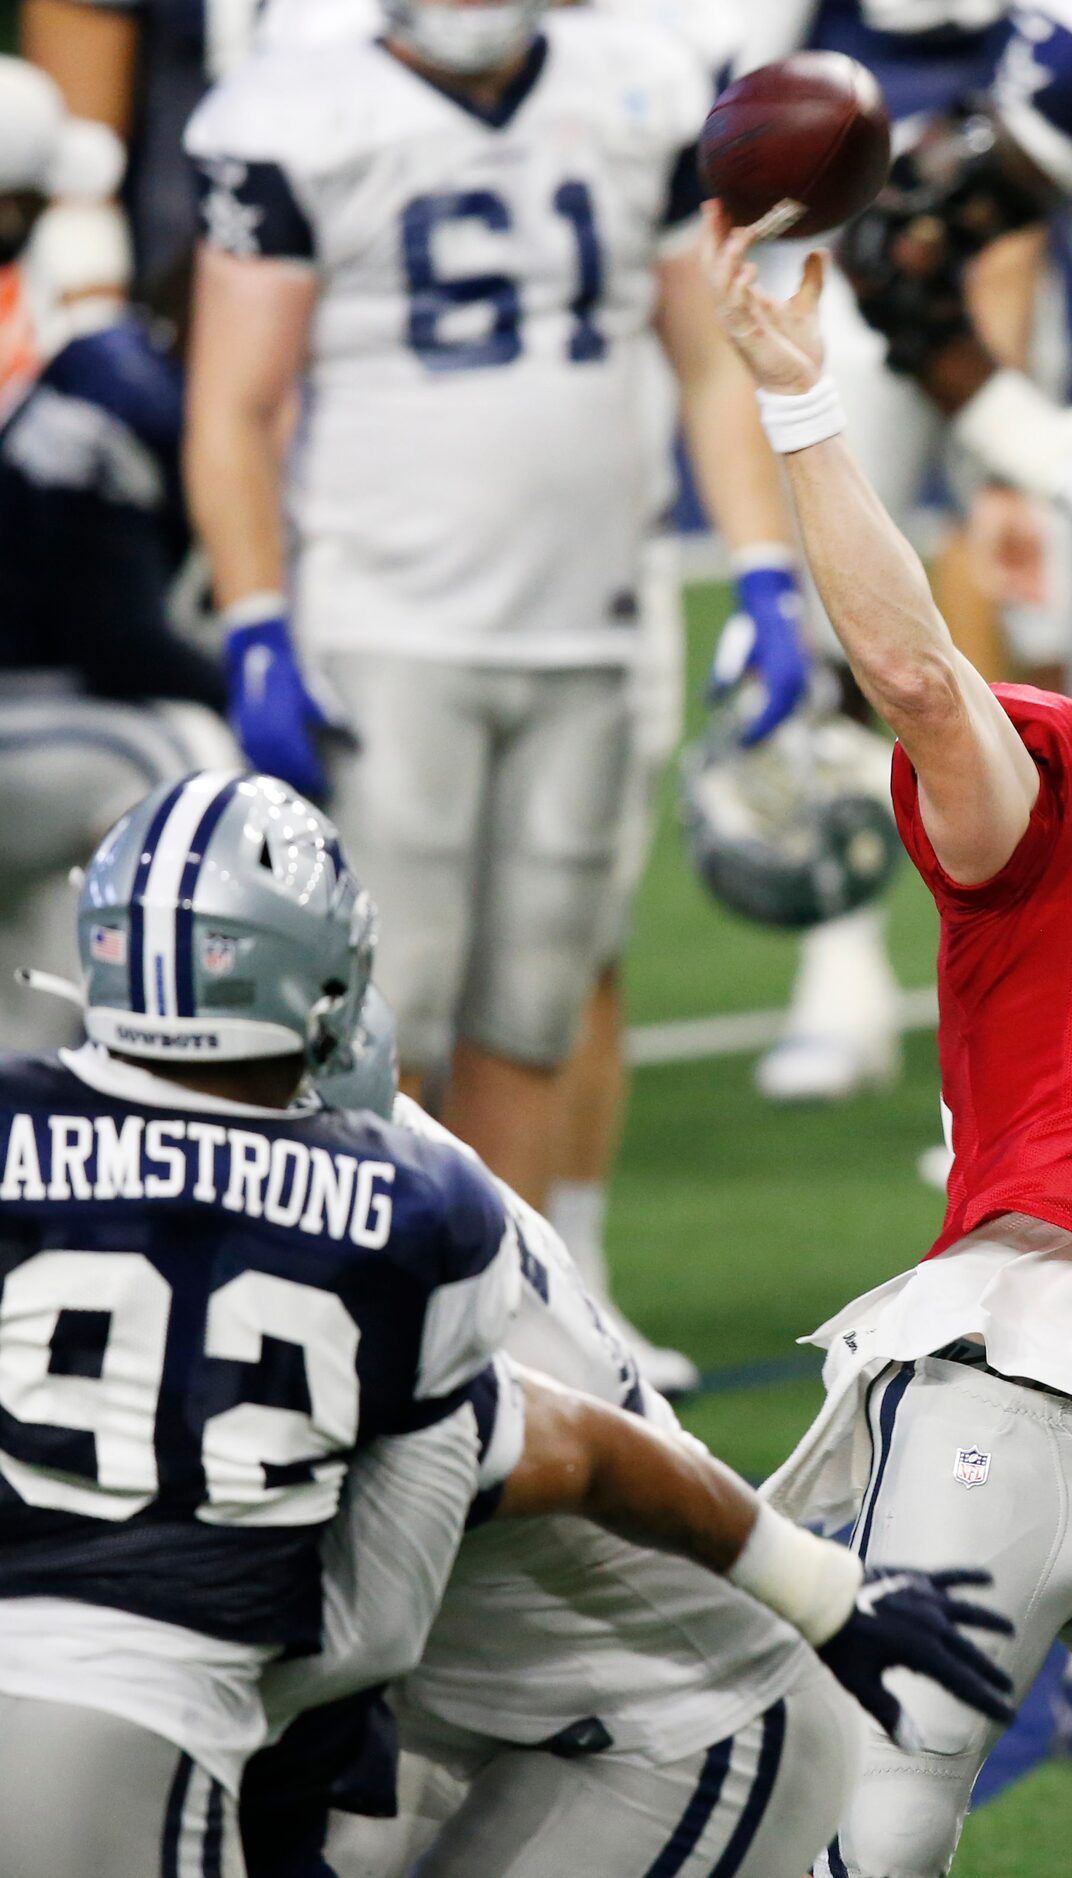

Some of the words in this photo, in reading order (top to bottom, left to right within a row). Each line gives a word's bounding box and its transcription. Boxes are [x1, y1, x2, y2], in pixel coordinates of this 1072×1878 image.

[402, 180, 608, 374] 61
[0, 1113, 396, 1250] ARMSTRONG
[0, 1249, 362, 1527] 92
